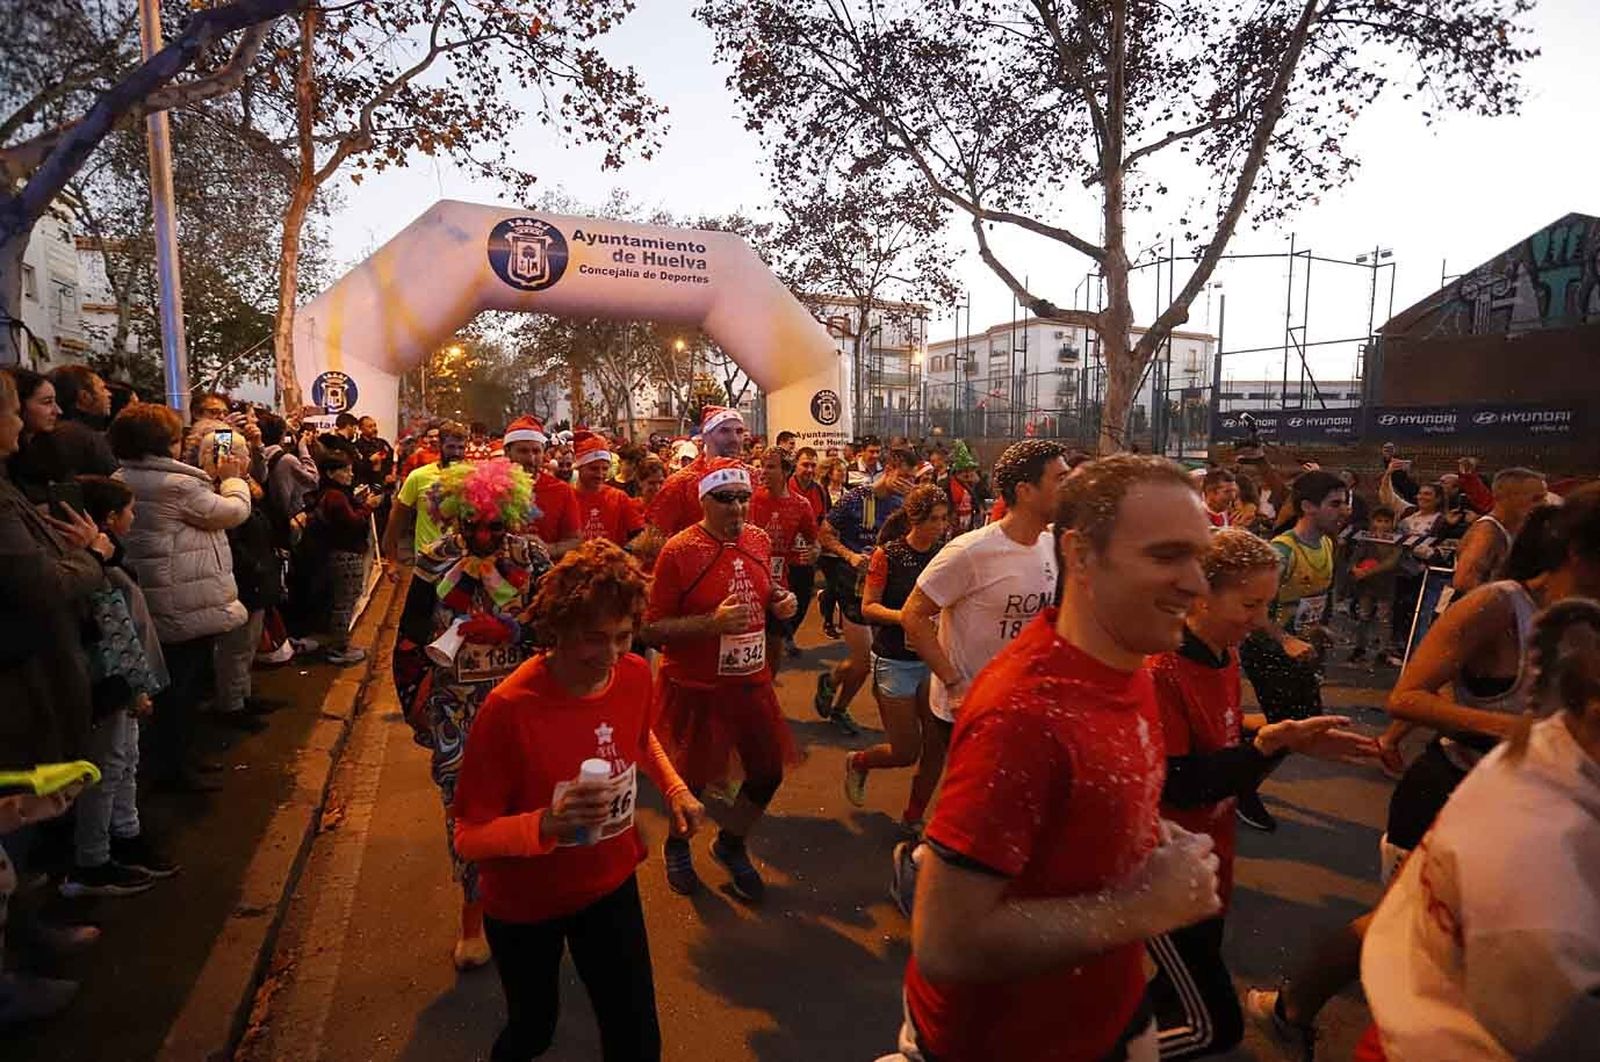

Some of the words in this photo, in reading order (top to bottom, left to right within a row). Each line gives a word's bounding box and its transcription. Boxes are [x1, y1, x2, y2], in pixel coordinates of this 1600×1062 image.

[572, 229, 706, 253] Ayuntamiento
[612, 249, 636, 263] de
[643, 251, 707, 270] Huelva
[643, 270, 657, 280] de
[660, 271, 709, 284] Deportes
[1306, 417, 1352, 427] HYUNDAI
[1400, 414, 1457, 425] HYUNDAI
[1501, 411, 1571, 423] HYUNDAI
[742, 644, 763, 664] 342
